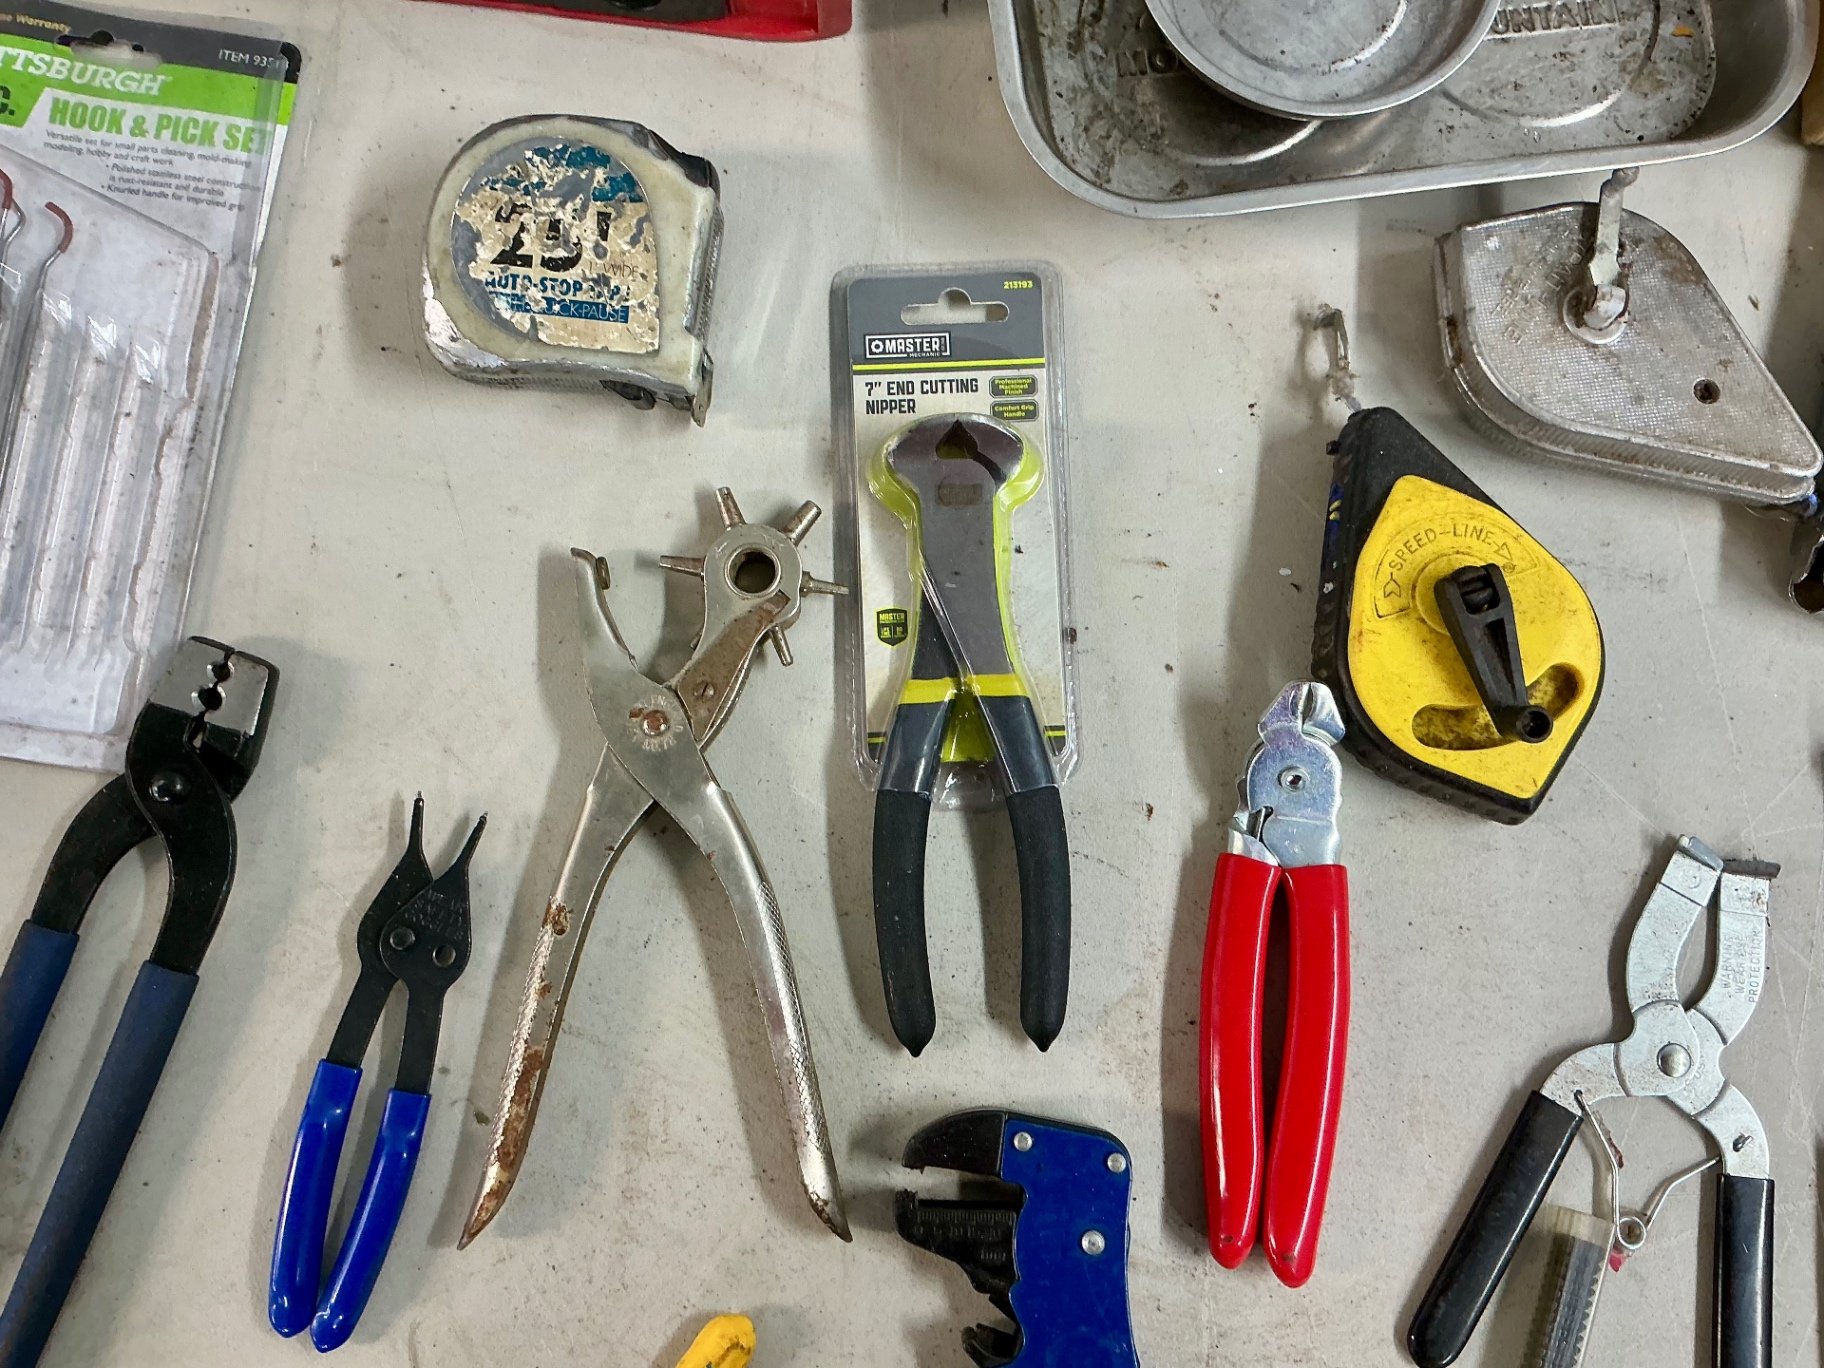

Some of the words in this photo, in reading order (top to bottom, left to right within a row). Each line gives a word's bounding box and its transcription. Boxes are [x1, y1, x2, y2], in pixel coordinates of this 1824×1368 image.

[16, 14, 71, 34] Warranty
[219, 49, 250, 64] ITEM
[49, 97, 126, 135] HOOK
[130, 114, 150, 139] &
[153, 113, 217, 147] PICK
[46, 129, 82, 143] Versatile
[85, 138, 97, 146] set
[100, 139, 112, 147] for
[115, 142, 136, 151] small
[137, 145, 158, 154] parts
[86, 147, 112, 159] hobby
[131, 154, 150, 163] craft
[152, 158, 173, 166] work
[111, 163, 146, 175] Polished
[148, 169, 182, 179] stainless
[107, 184, 141, 196] Knurled
[142, 189, 169, 199] handle
[171, 192, 184, 200] for
[186, 196, 227, 207] improved
[174, 184, 190, 192] and
[192, 186, 224, 196] durable
[1003, 280, 1033, 289] 213193
[885, 337, 940, 354] MASTER
[865, 381, 882, 397] 7"
[887, 380, 915, 396] END
[921, 378, 979, 395] CUTTING
[866, 398, 916, 415] NIPPER
[1389, 525, 1494, 572] SPEED-LINE
[1748, 930, 1761, 1003] PROTECTION
